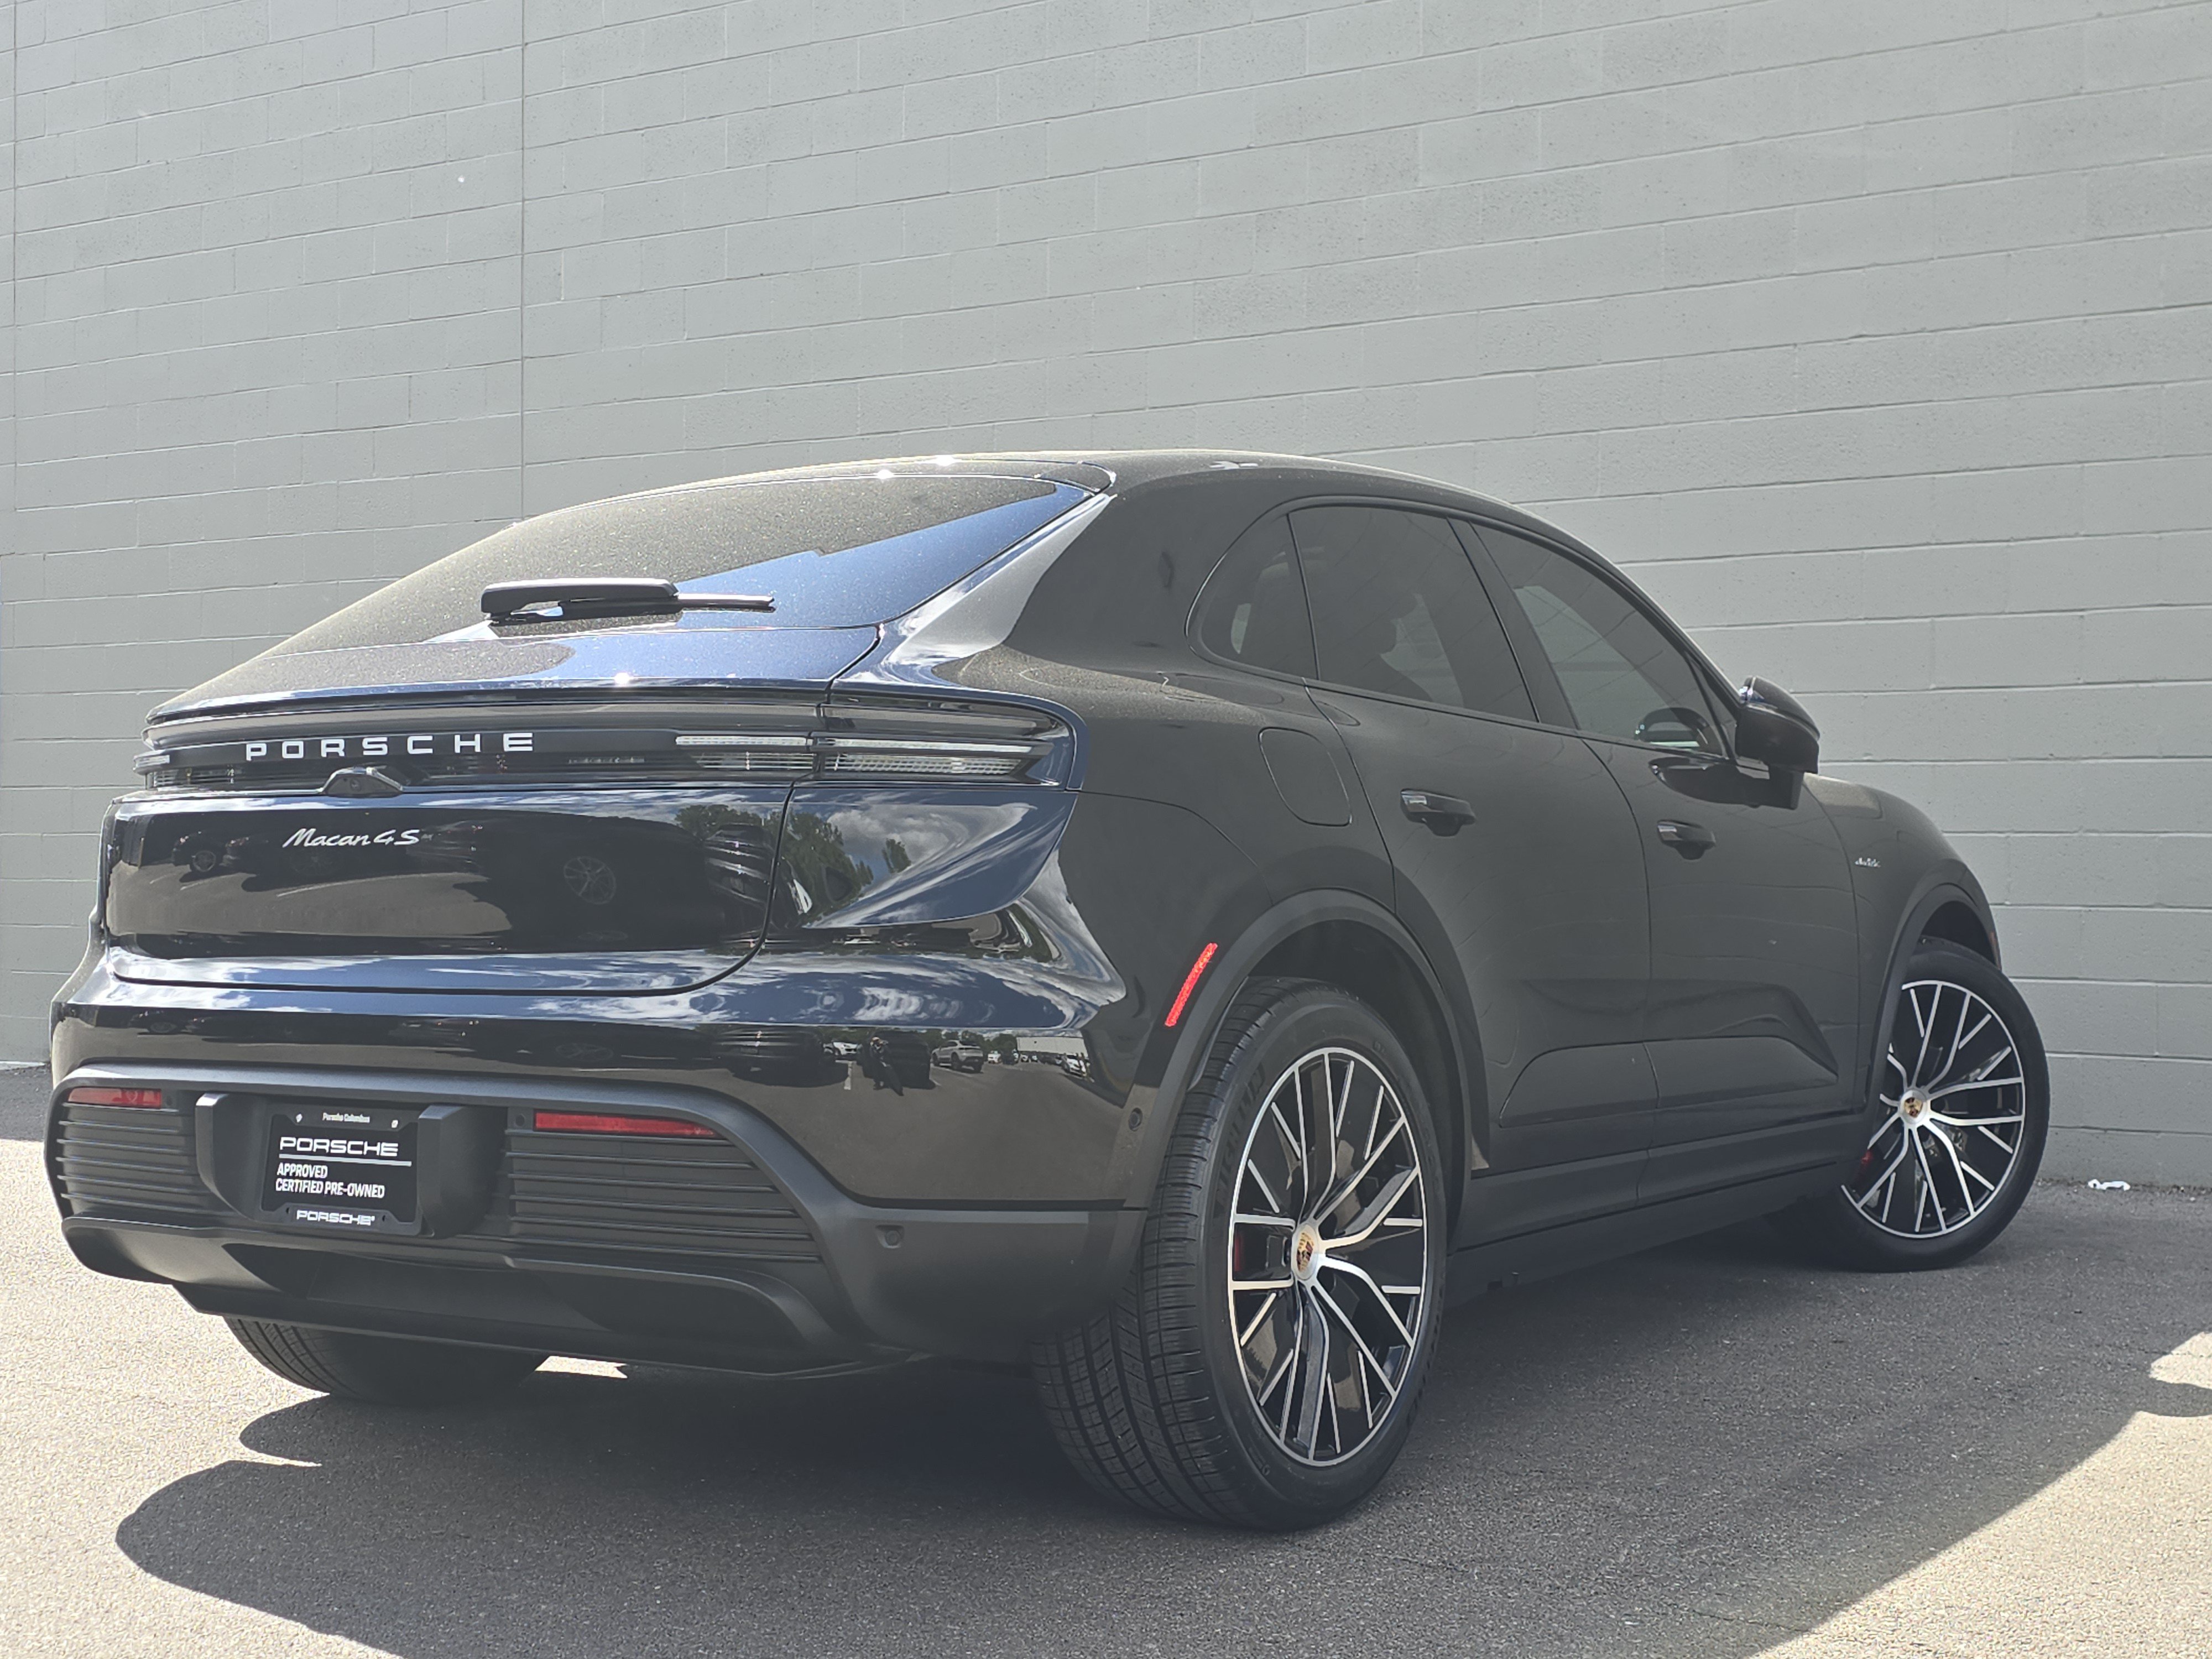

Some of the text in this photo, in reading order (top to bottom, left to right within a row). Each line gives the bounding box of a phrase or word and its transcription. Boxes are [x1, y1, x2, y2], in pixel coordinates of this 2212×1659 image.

[246, 733, 533, 761] PORSCHE
[282, 828, 371, 848] Macan
[279, 1136, 399, 1157] PORSCHE
[276, 1162, 328, 1179] APPROVED
[275, 1177, 385, 1198] CERTIFIED PRE-OWNED
[296, 1209, 372, 1226] PORSCHE
